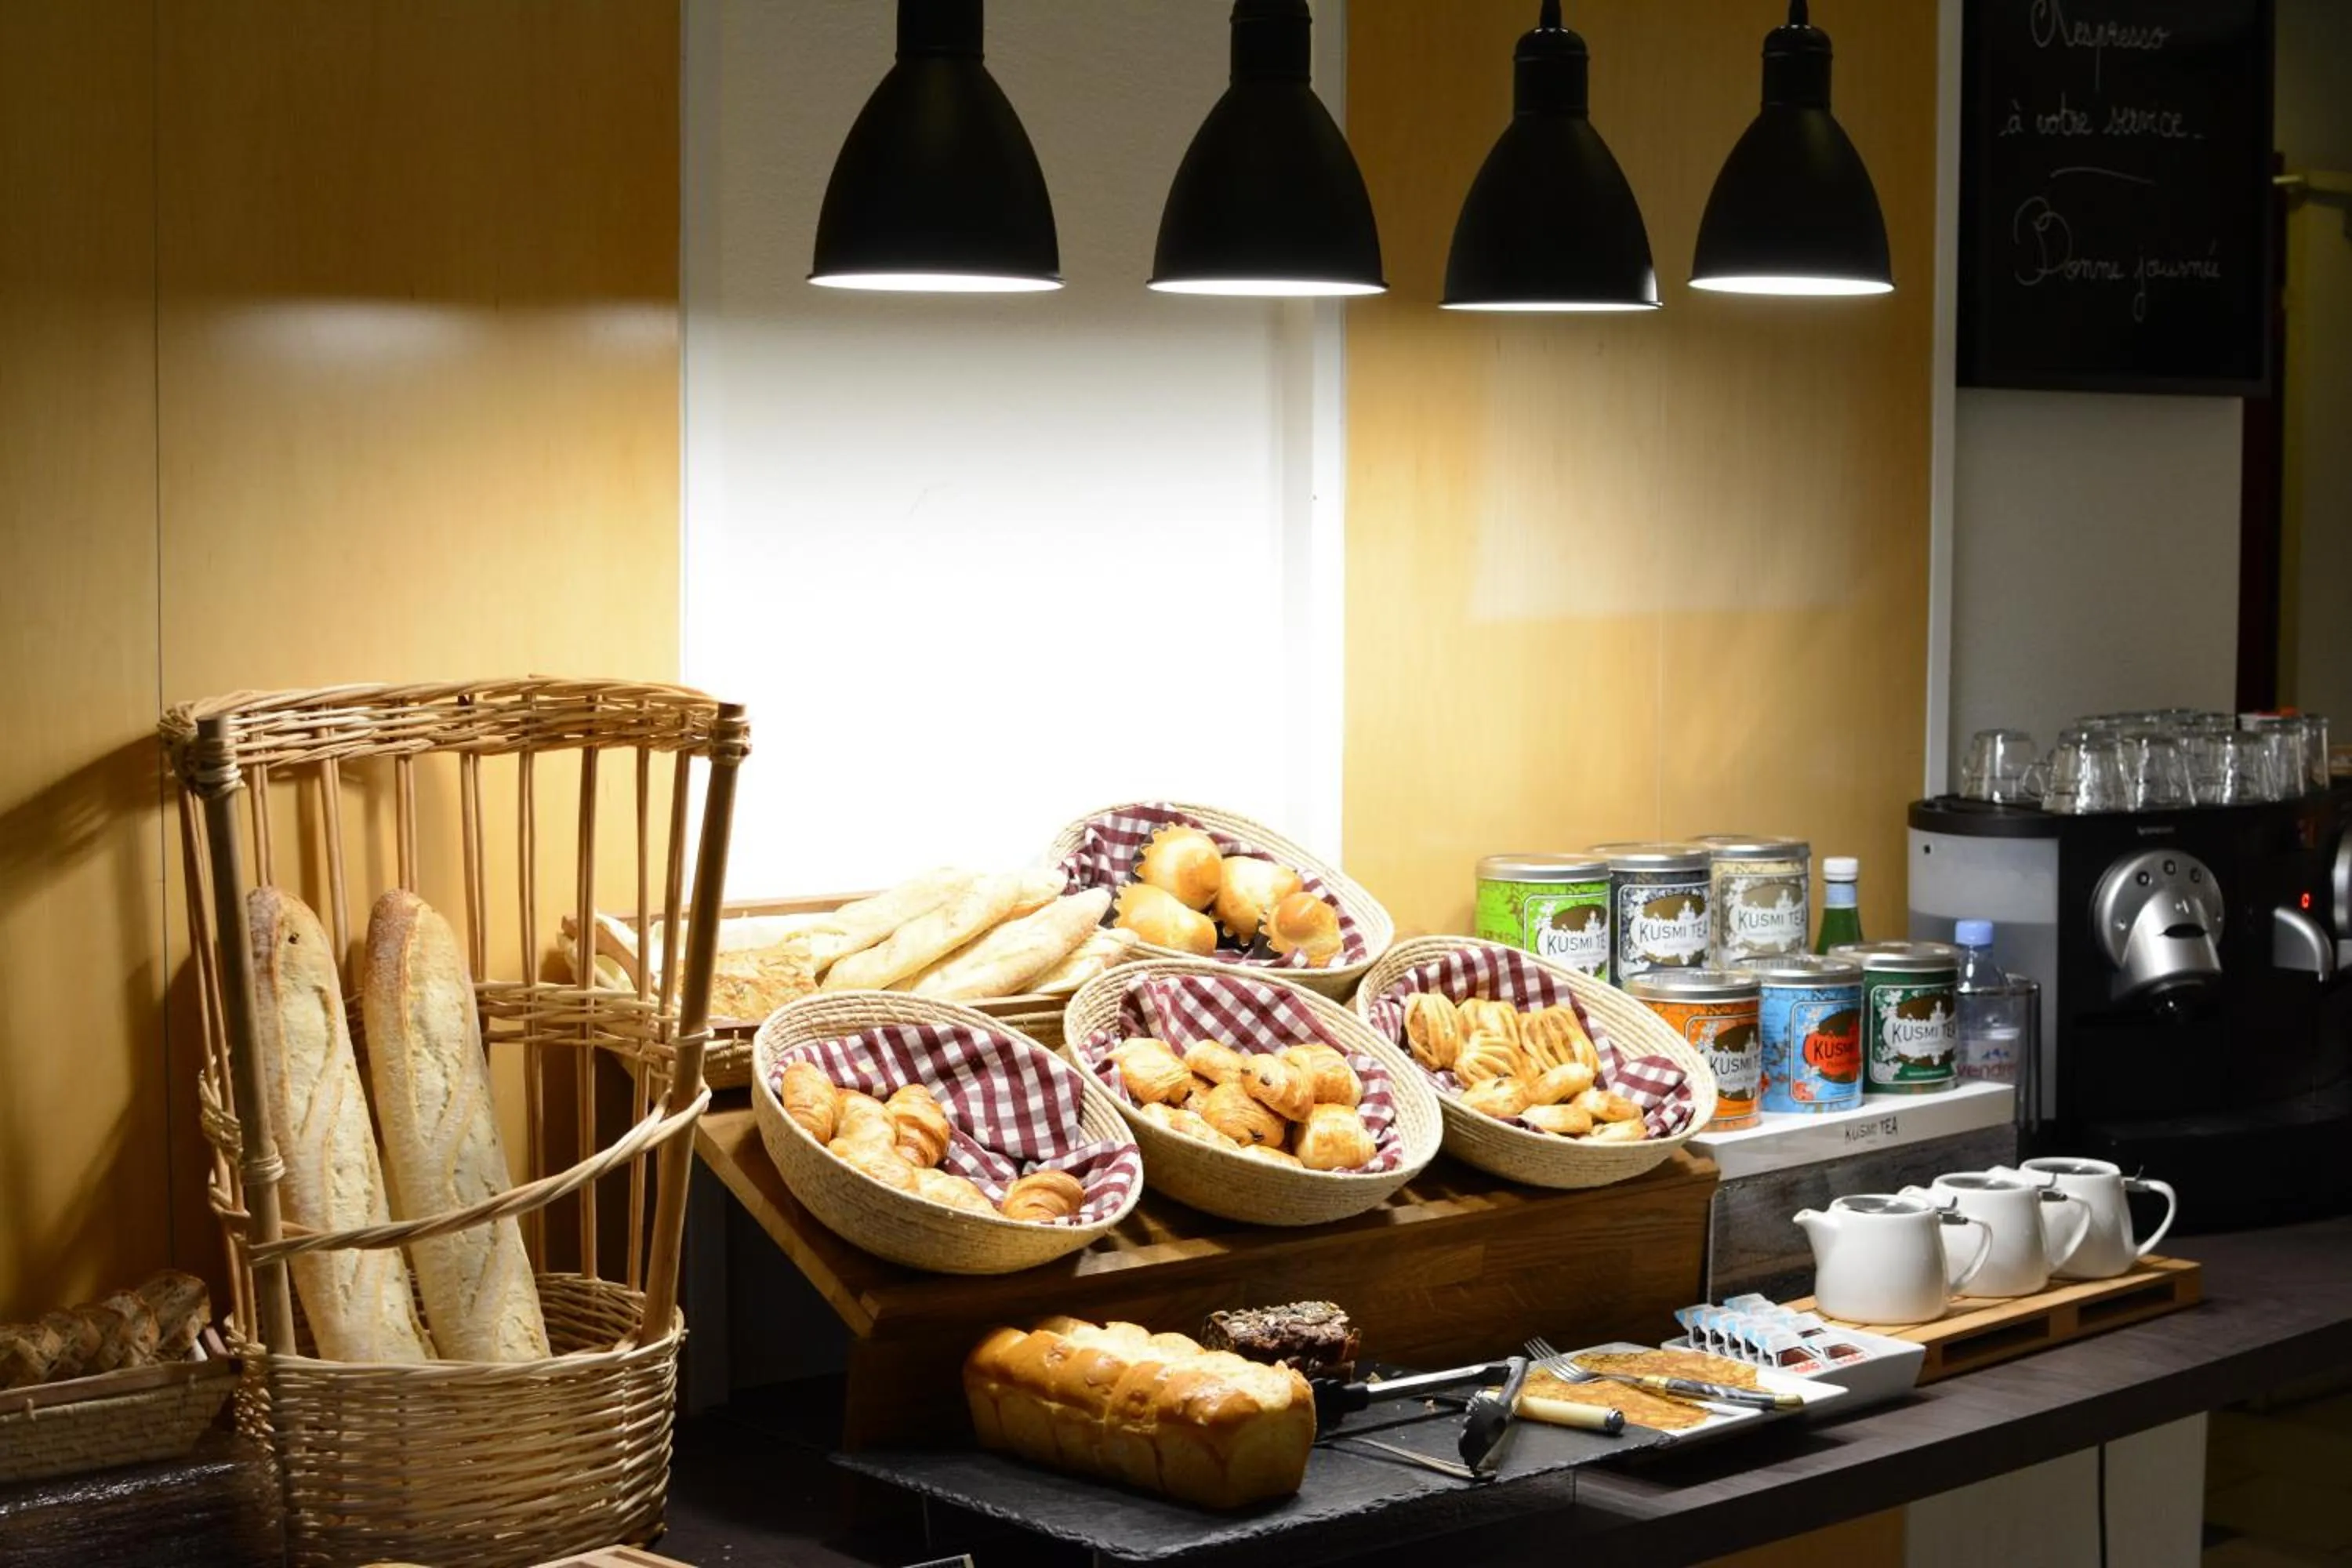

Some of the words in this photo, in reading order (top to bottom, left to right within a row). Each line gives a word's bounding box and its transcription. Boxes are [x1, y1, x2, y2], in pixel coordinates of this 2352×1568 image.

[2036, 92, 2094, 136] votre
[2013, 195, 2125, 286] Bonne
[1738, 909, 1784, 929] KUSMI
[1639, 922, 1686, 942] KUSMI
[1547, 934, 1592, 955] KUSMI
[1892, 1022, 1938, 1044] KUSMI
[1879, 1116, 1898, 1135] TEA
